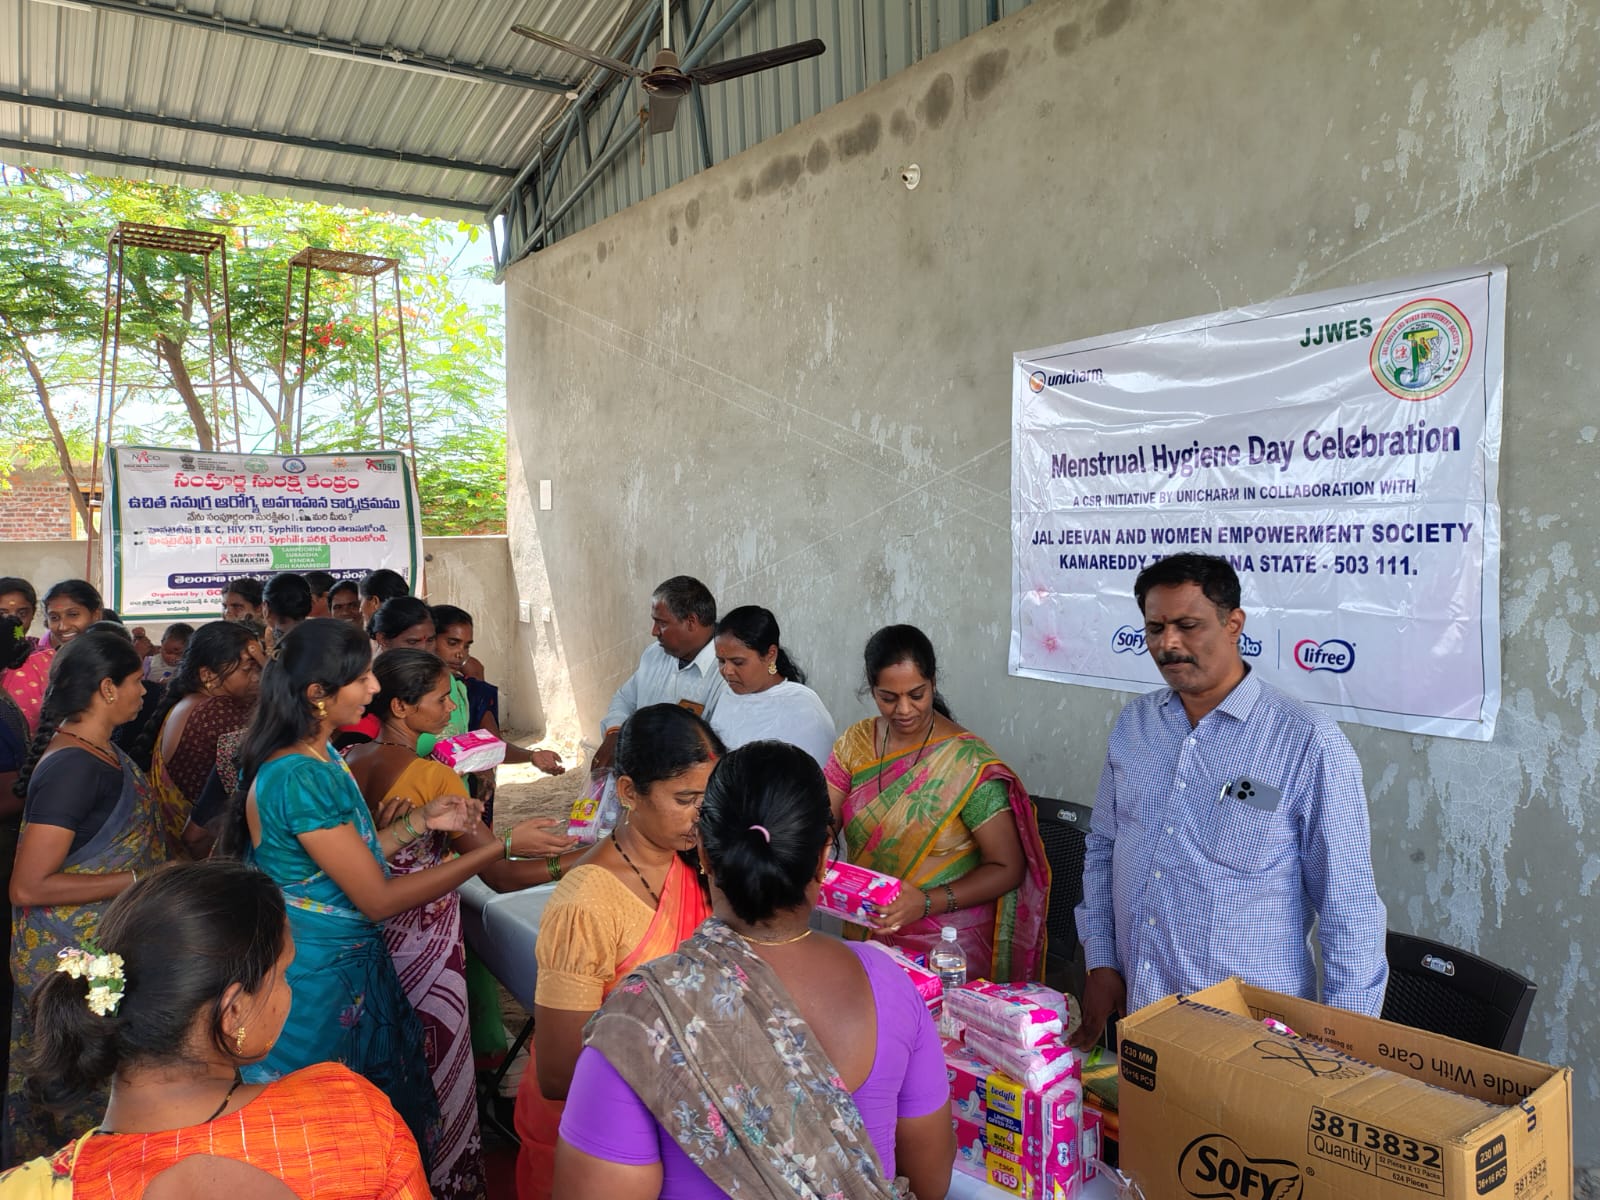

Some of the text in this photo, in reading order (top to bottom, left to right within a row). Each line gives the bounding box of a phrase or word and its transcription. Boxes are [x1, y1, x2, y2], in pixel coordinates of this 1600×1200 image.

[1300, 318, 1373, 347] JJWES
[1048, 368, 1103, 386] unicharm
[1052, 419, 1460, 478] Menstrual Hygiene Day Celebration
[1073, 479, 1416, 507] A CSR INITIATIVE BY UNICHARM IN COLLABORATION WITH
[204, 526, 212, 534] &
[268, 525, 303, 535] Syphilis
[1032, 522, 1473, 545] JAL JEEVAN AND WOMEN EMPOWERMENT SOCIETY
[269, 535, 304, 545] Syphilis
[1060, 554, 1147, 570] KAMAREDDY
[1260, 555, 1317, 573] STATE
[1334, 556, 1369, 574] 503
[1376, 556, 1417, 575] 111.
[1304, 647, 1346, 665] lifree
[1124, 1045, 1153, 1064] 230 MM
[1378, 1043, 1424, 1071] Care
[1140, 1074, 1154, 1087] PCS
[1432, 1058, 1476, 1088] With
[1006, 1131, 1015, 1145] 4
[1311, 1110, 1441, 1169] 3813832
[1314, 1135, 1371, 1170] Quantity
[1480, 1149, 1492, 1163] 230
[1195, 1145, 1285, 1200] SOFY
[1406, 1176, 1429, 1189] Pieces
